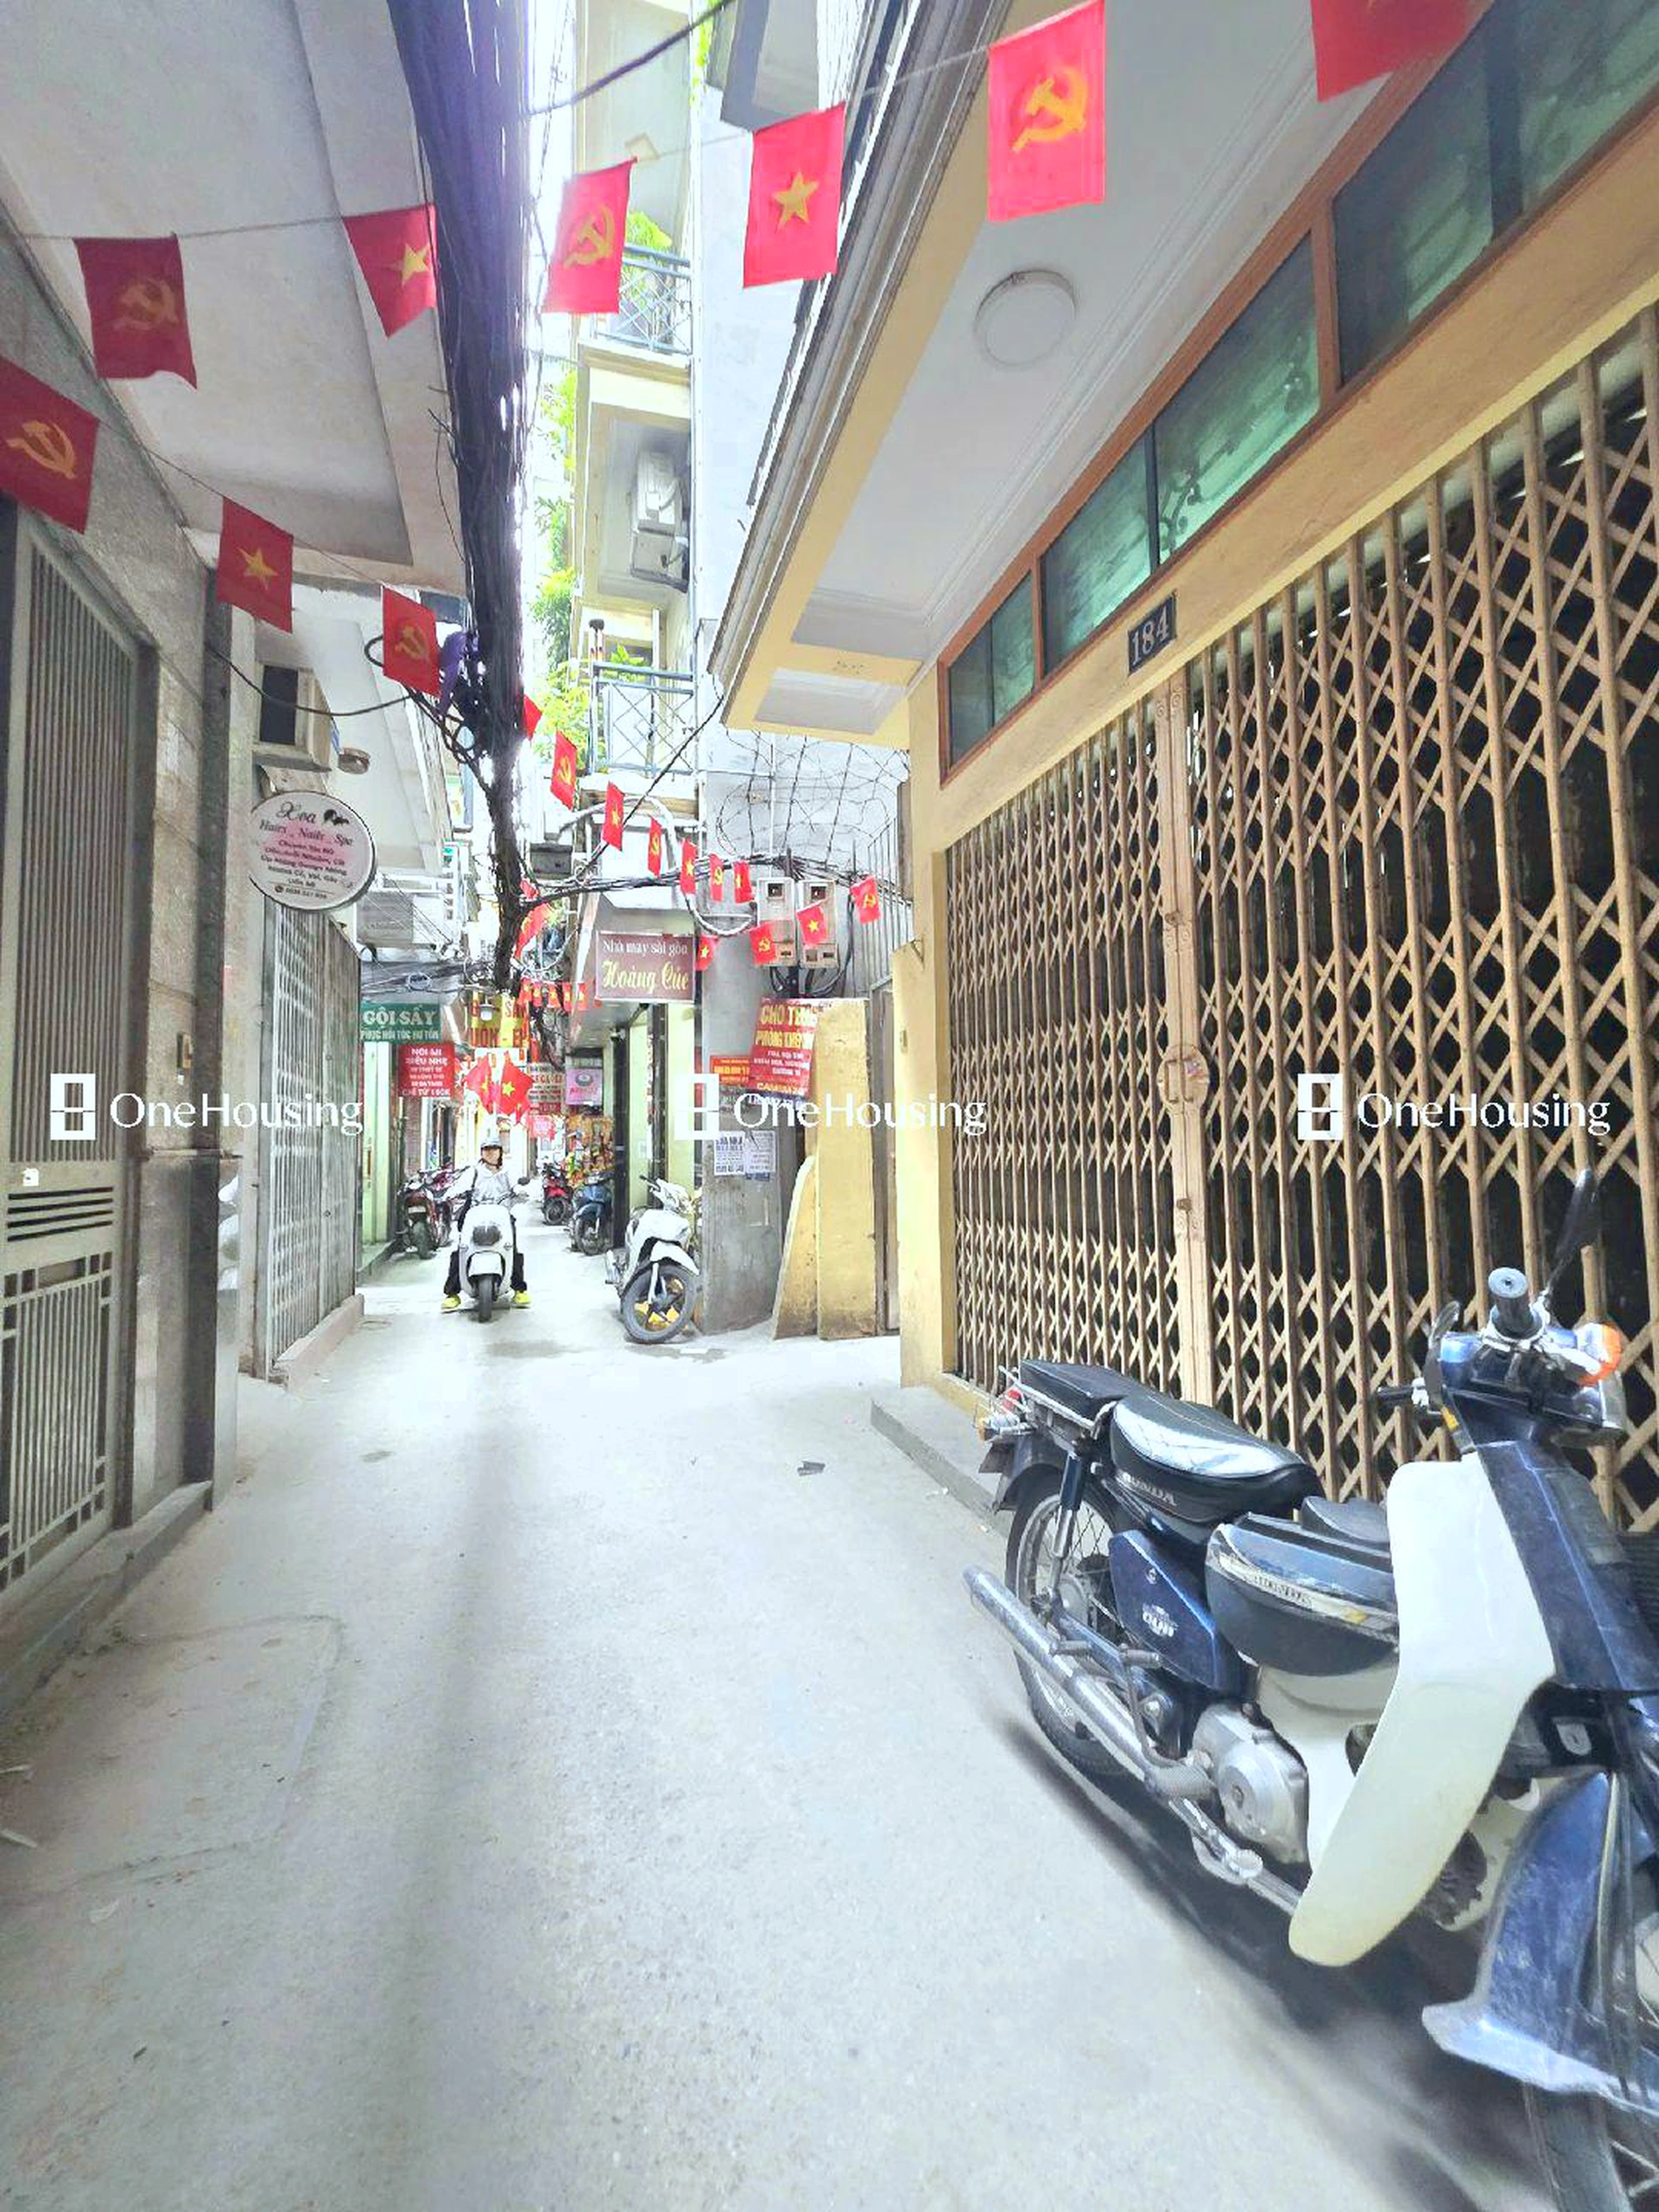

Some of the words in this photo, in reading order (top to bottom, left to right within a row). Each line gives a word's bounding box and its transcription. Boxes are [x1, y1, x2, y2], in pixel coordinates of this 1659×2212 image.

[1132, 605, 1169, 665] 184
[603, 939, 624, 954] Nhà
[626, 941, 649, 958] may
